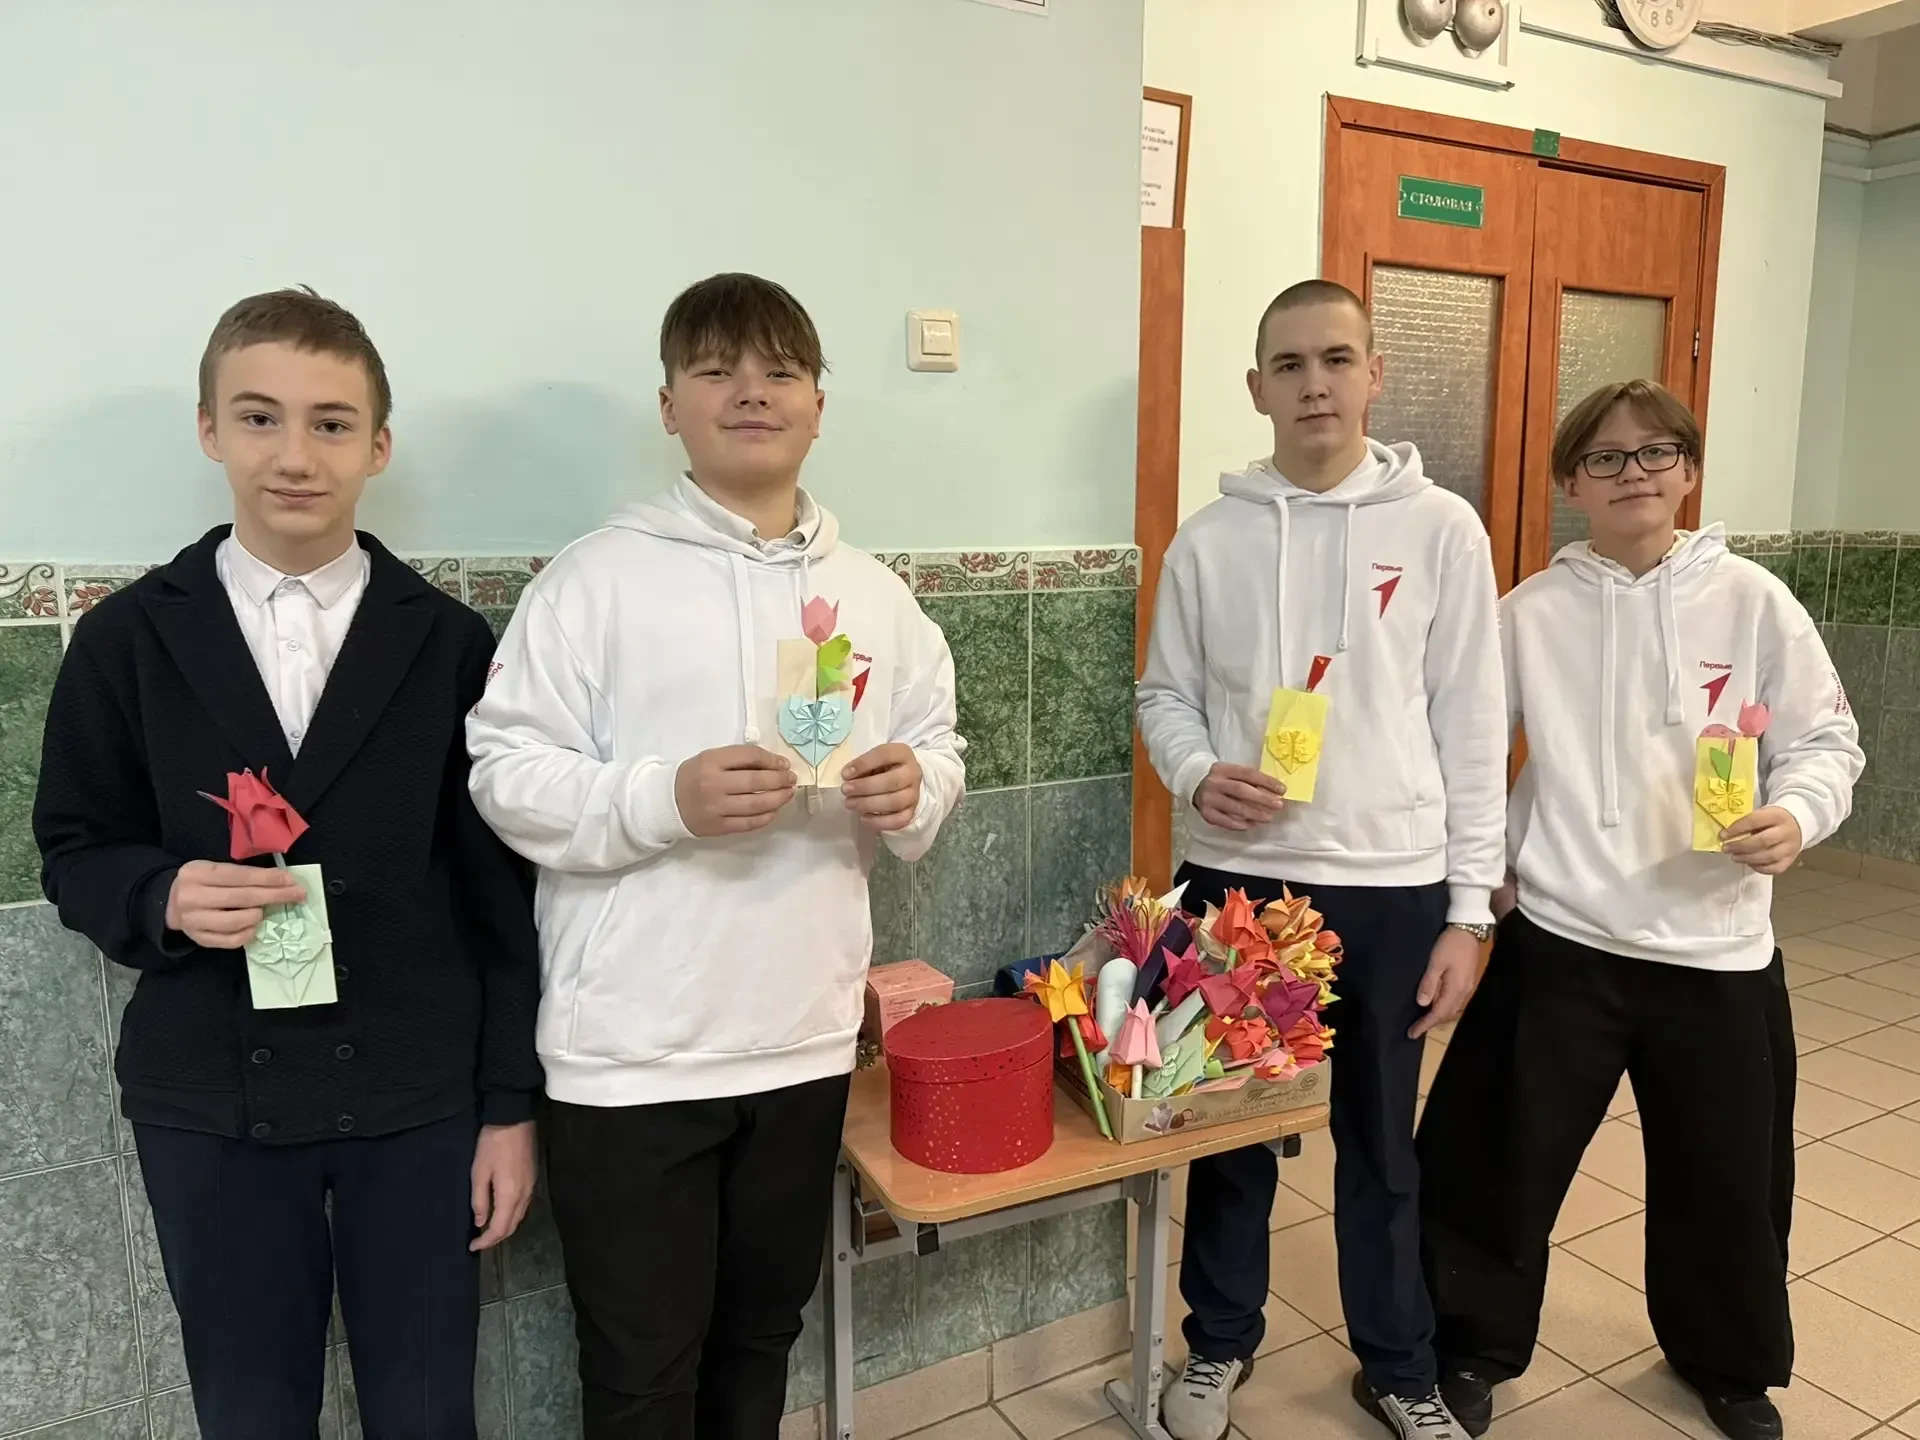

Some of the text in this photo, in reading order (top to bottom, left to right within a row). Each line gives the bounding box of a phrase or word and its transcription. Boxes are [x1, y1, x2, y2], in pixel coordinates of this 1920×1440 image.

[1409, 191, 1473, 212] СТОЛОВАЯ
[1371, 563, 1403, 572] Первые
[852, 652, 873, 663] ервые
[1699, 660, 1733, 671] Первые
